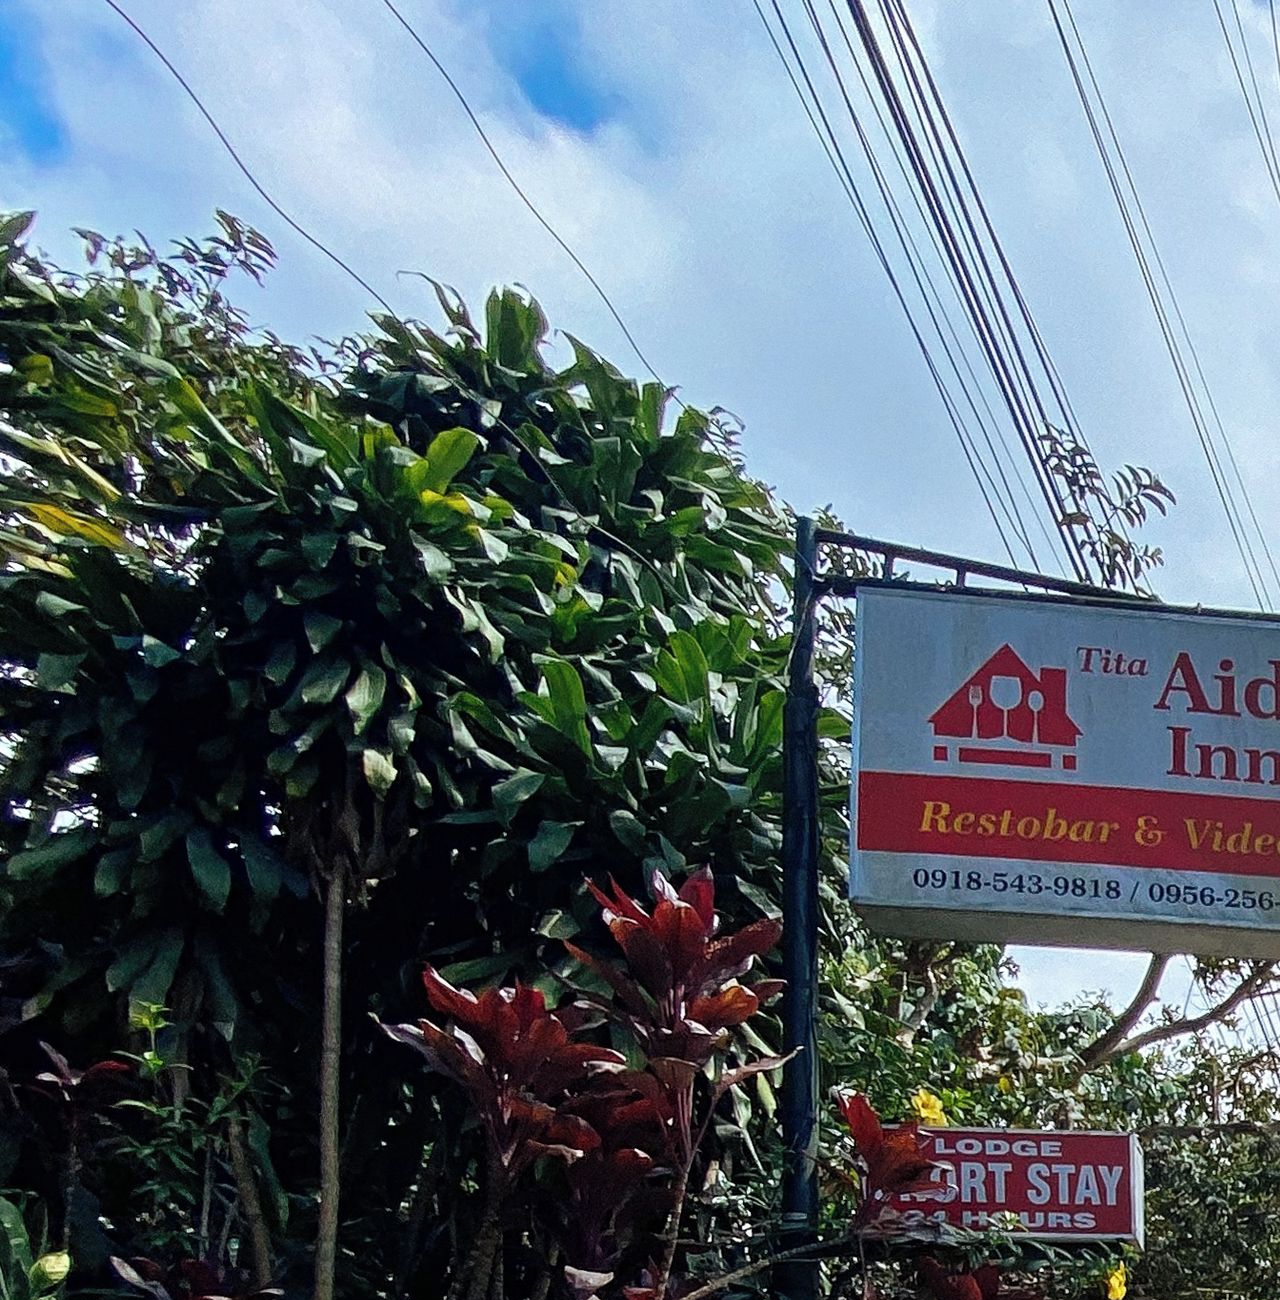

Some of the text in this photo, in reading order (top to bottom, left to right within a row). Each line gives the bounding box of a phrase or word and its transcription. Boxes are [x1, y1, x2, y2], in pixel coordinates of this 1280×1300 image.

[1076, 646, 1149, 677] Tita
[918, 799, 1120, 844] Restobar
[1134, 814, 1167, 848] &
[912, 866, 1122, 901] 0918-543-9818
[935, 1137, 1063, 1157] LODGE
[900, 1160, 1123, 1207] ORT STAY
[962, 1209, 1097, 1229] HURS
